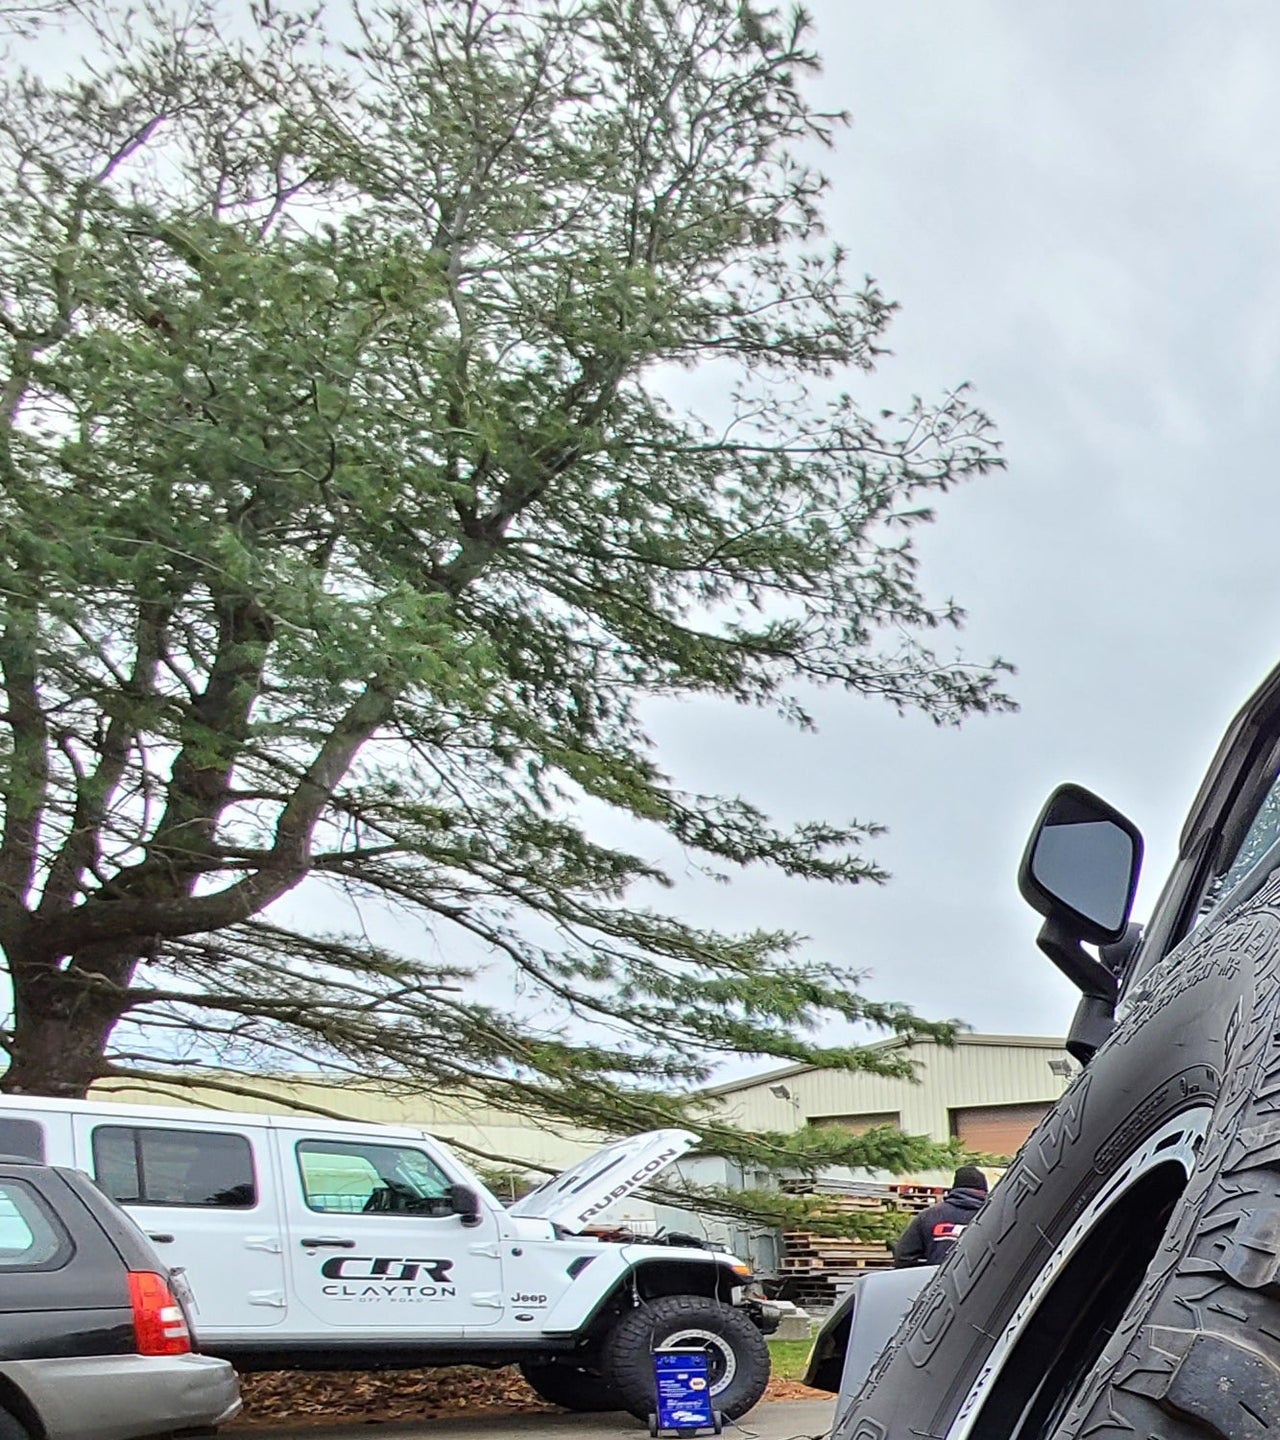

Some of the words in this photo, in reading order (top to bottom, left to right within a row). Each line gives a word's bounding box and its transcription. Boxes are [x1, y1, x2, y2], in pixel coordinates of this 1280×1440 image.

[577, 1147, 678, 1223] RUBICON
[906, 1074, 1093, 1369] CLAW
[322, 1285, 456, 1297] CLAYTON
[511, 1292, 548, 1304] Jeep
